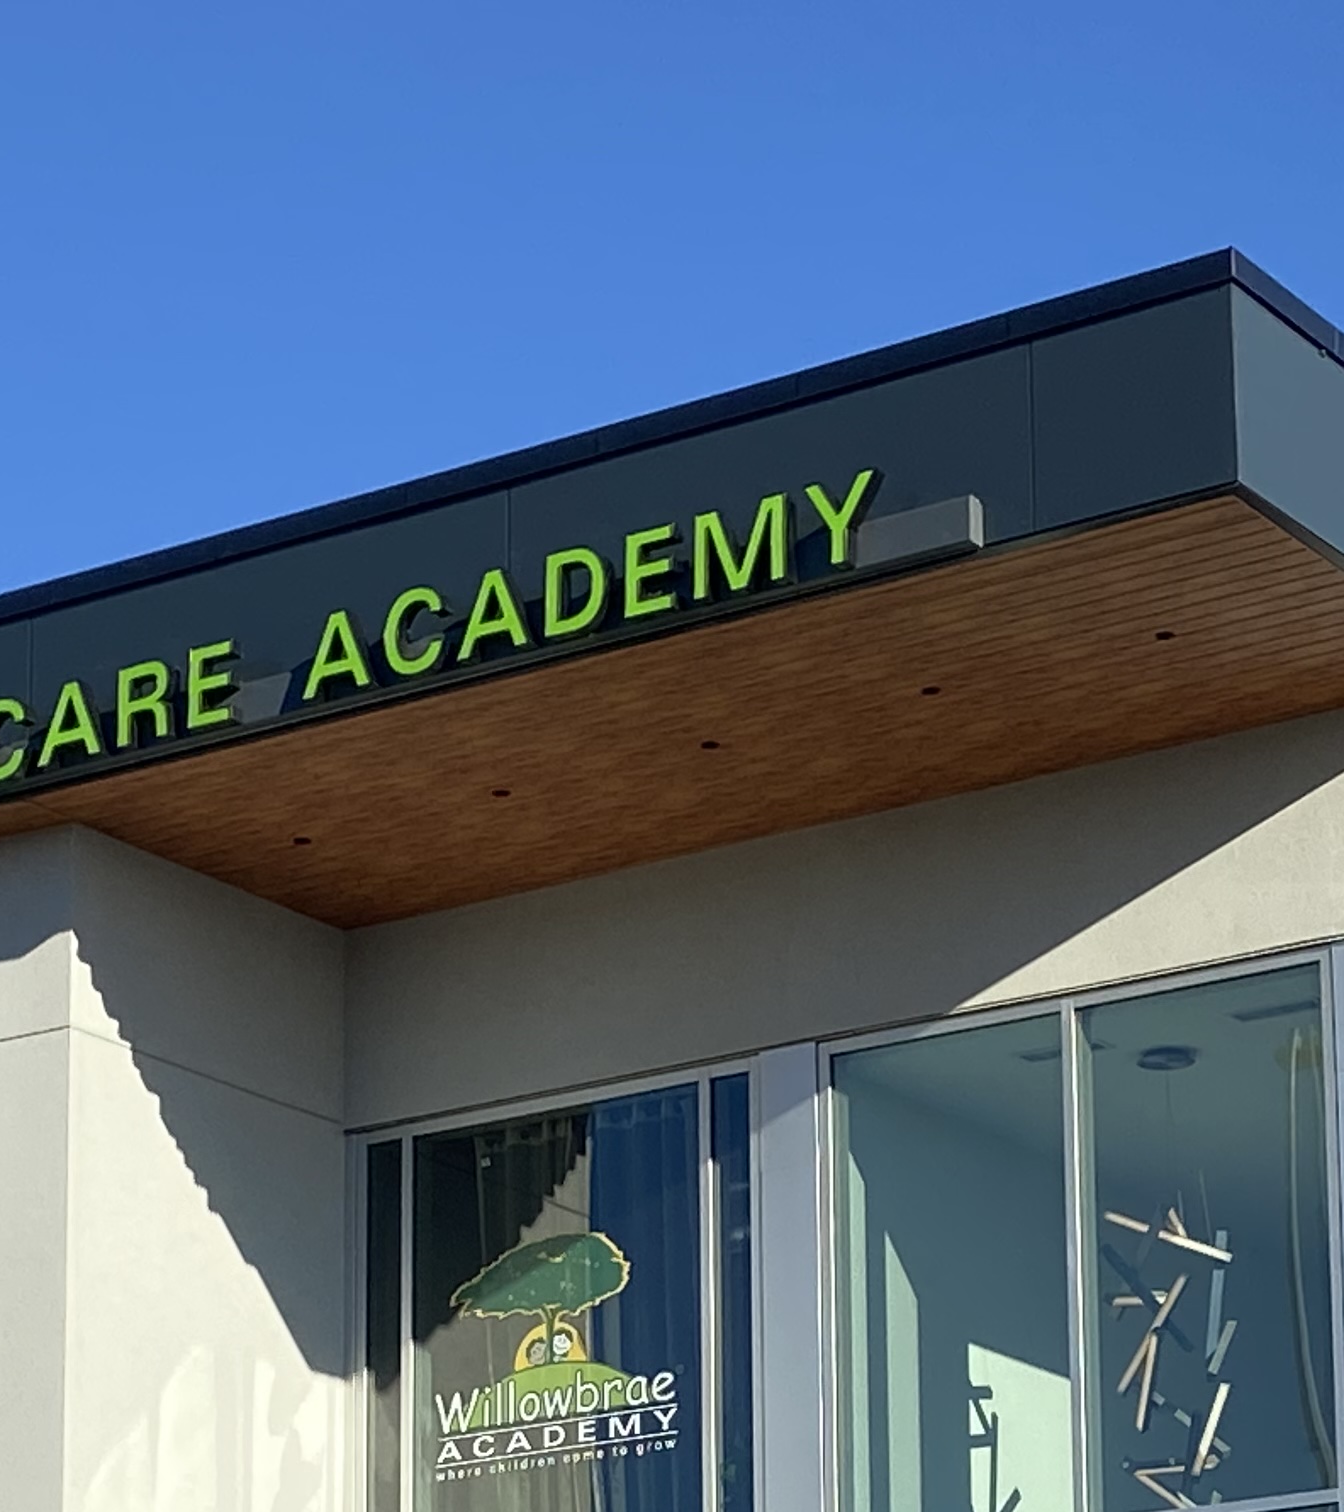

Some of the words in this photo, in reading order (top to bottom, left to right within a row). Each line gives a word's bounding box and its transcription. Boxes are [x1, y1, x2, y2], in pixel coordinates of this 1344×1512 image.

[302, 468, 877, 701] ACADEMY
[435, 1369, 676, 1435] Willowbrae
[435, 1465, 482, 1483] where
[489, 1455, 556, 1475] children
[562, 1448, 605, 1465] come
[612, 1443, 629, 1458] to
[635, 1438, 677, 1457] grow
[436, 1406, 678, 1464] ACADEMY
